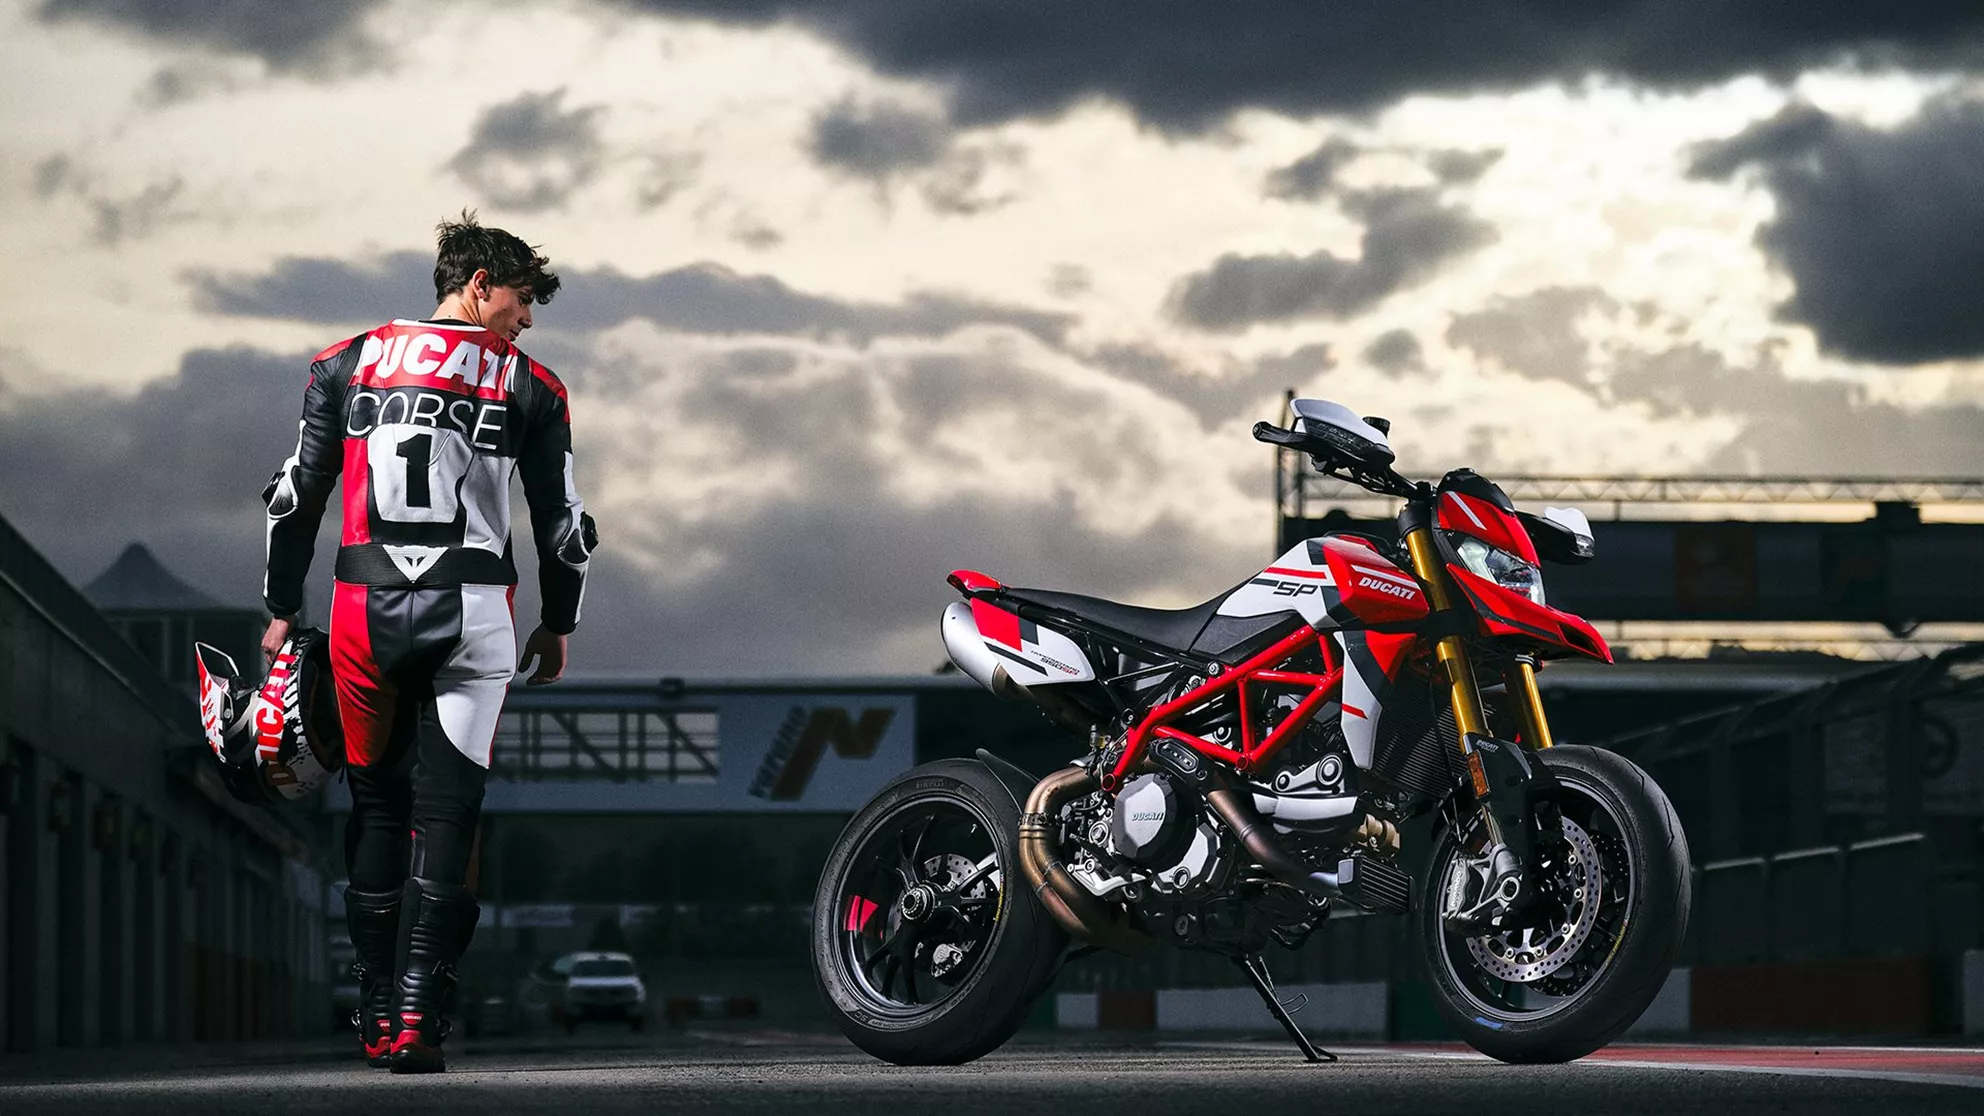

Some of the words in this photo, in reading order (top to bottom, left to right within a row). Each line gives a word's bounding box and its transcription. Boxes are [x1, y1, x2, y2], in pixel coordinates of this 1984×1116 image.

[346, 391, 508, 450] CORSE
[396, 432, 433, 509] 1
[1273, 582, 1319, 597] SP
[1358, 576, 1416, 600] DUCATI
[1131, 811, 1165, 822] DUCATI
